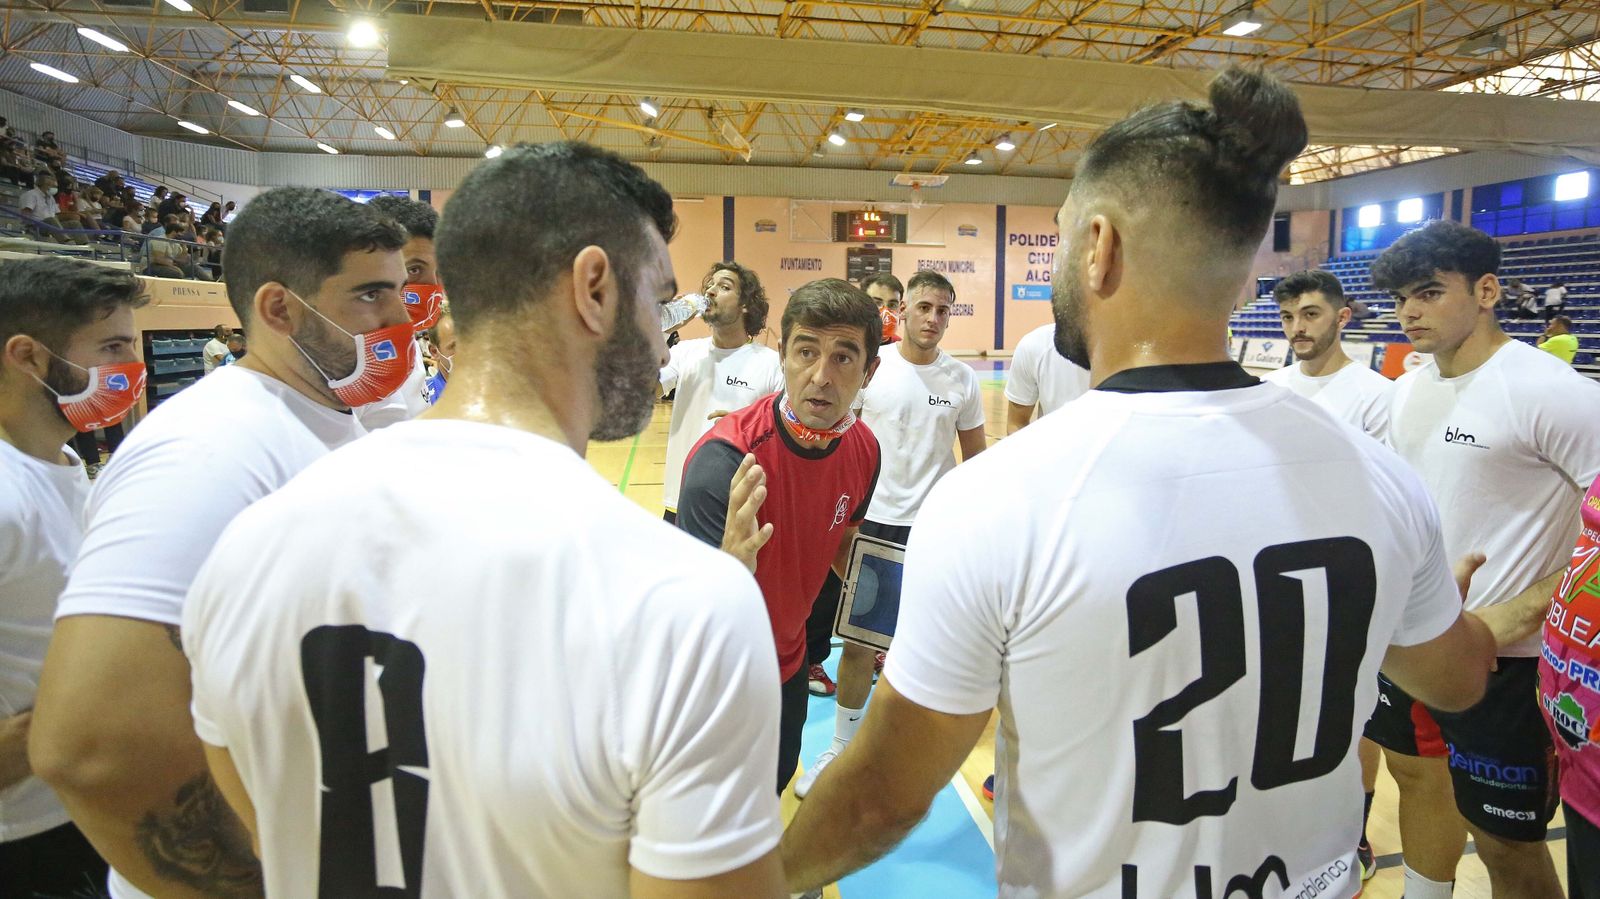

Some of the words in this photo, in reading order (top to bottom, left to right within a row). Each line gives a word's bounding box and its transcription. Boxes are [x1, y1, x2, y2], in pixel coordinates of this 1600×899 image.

[780, 257, 822, 271] AYUNTAMIENTO
[1028, 252, 1054, 264] CIU
[172, 287, 200, 296] PRENSA
[726, 375, 748, 386] blm
[928, 394, 951, 406] blm
[1445, 426, 1475, 443] blm
[1126, 536, 1377, 825] 20
[1570, 661, 1600, 691] PR
[1295, 860, 1348, 899] oblanco
